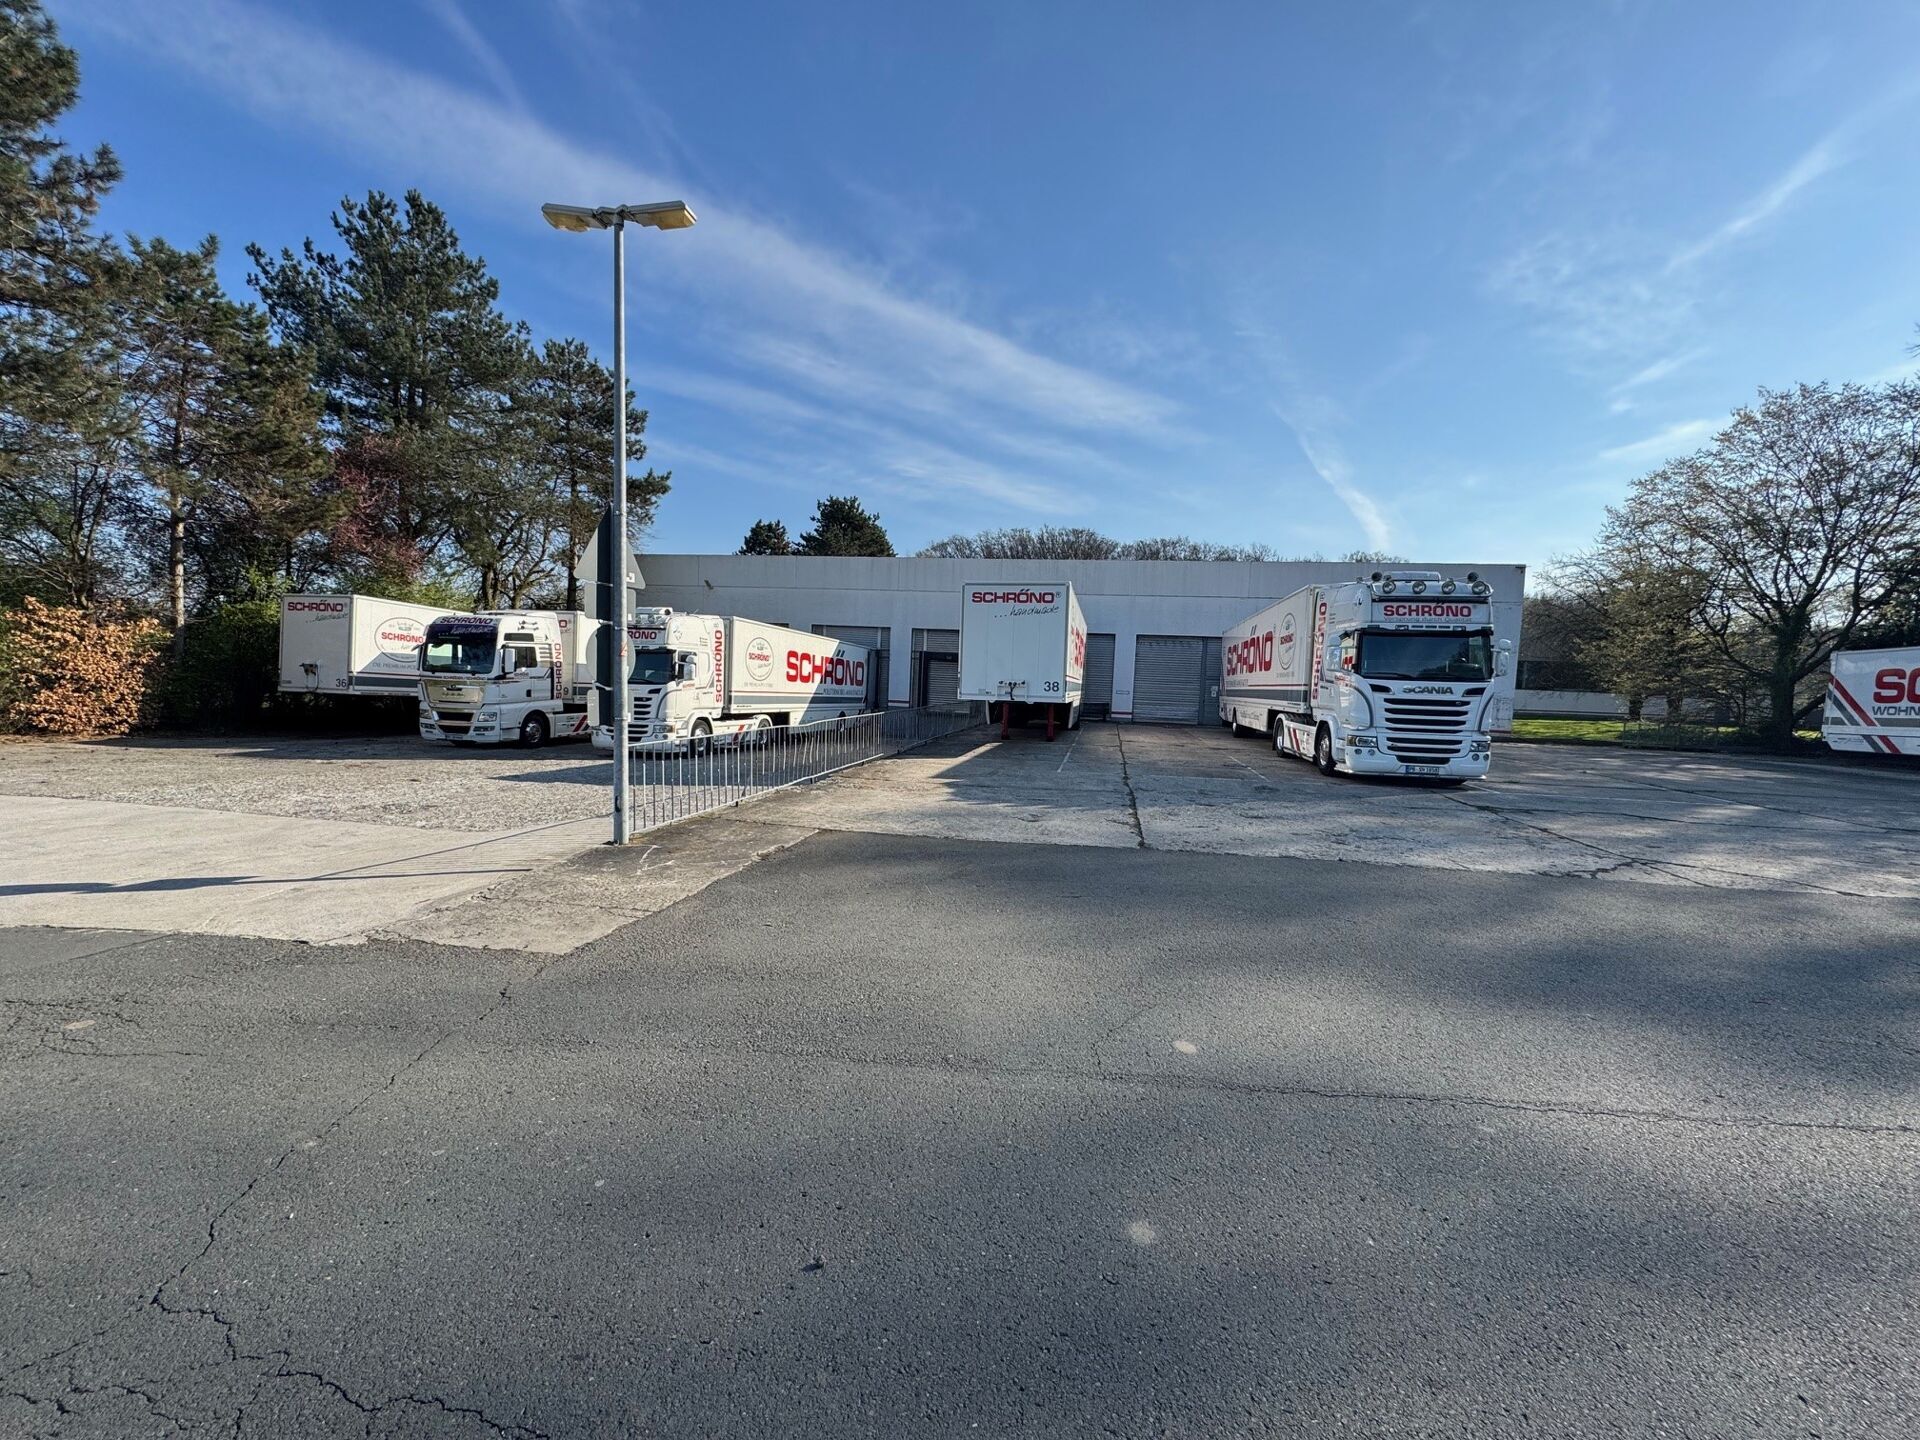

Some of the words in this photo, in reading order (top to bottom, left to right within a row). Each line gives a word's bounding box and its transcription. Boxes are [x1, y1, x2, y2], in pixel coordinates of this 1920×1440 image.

[972, 588, 1055, 604] SCHRÖNO
[335, 679, 347, 688] 36
[1044, 682, 1060, 692] 38
[1402, 686, 1454, 695] SCANIA
